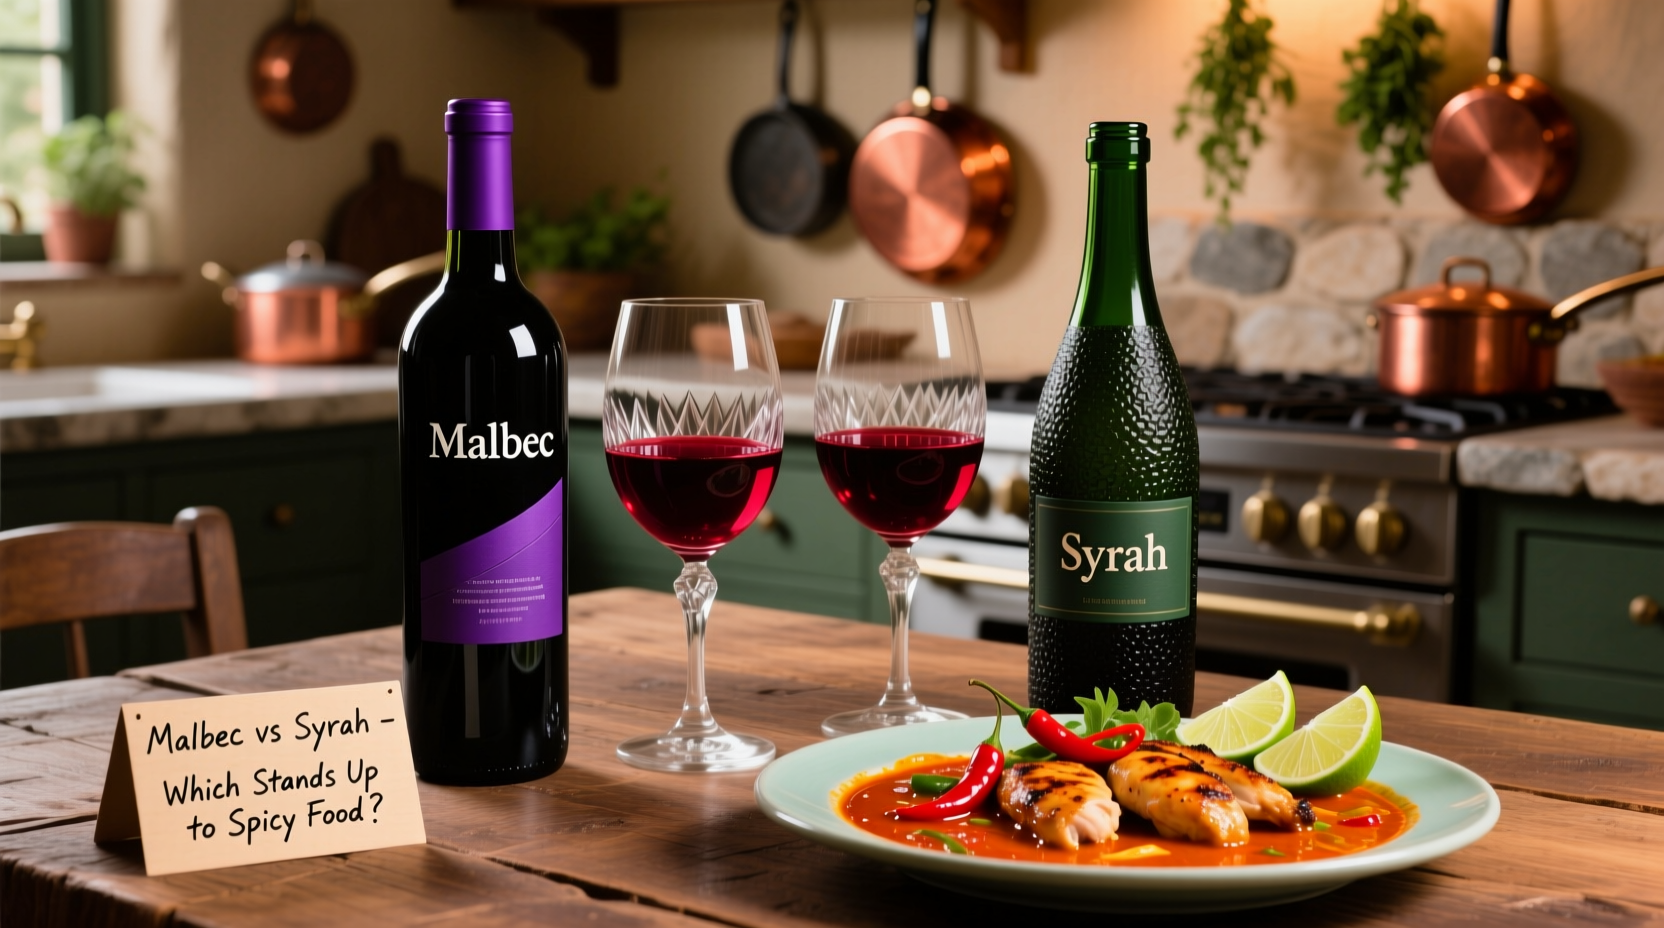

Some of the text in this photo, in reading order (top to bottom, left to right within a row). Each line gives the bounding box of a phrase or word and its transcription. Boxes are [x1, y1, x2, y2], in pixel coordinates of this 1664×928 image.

[429, 421, 554, 460] Malbec
[1061, 532, 1168, 583] Syrah
[147, 720, 244, 755] Malbec
[256, 724, 281, 743] vs
[295, 707, 369, 752] Syrah
[163, 758, 379, 806] Which Stands Up
[187, 792, 384, 846] to Spicy Food?
